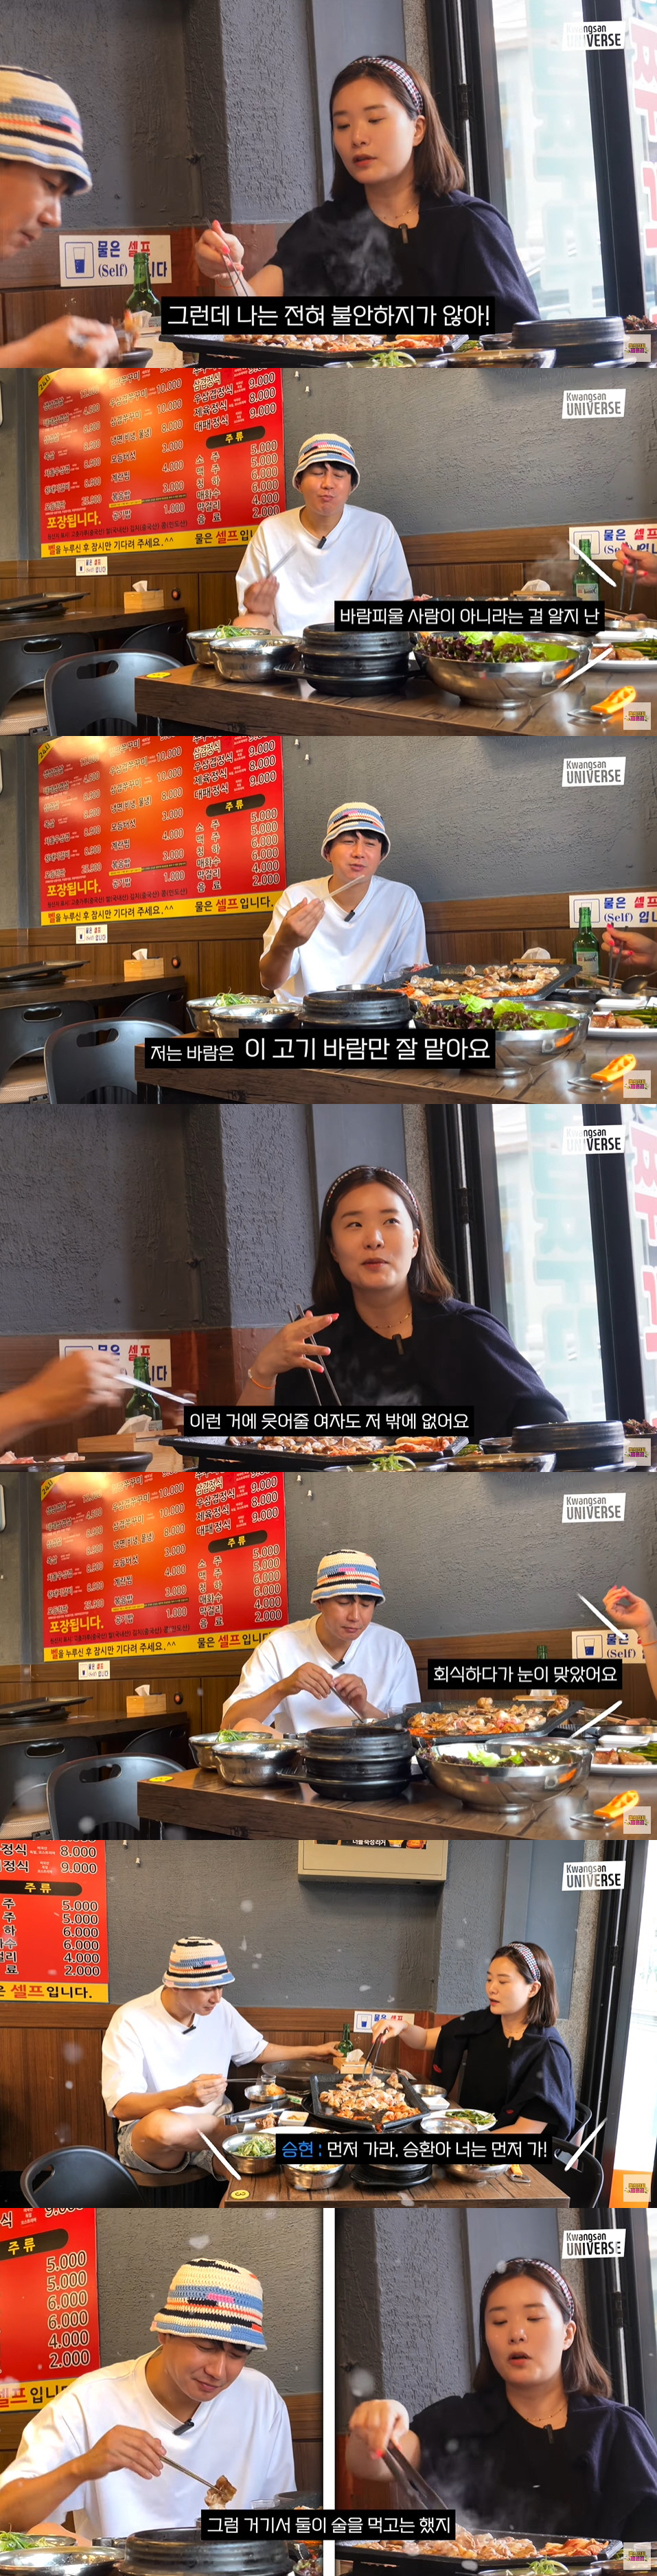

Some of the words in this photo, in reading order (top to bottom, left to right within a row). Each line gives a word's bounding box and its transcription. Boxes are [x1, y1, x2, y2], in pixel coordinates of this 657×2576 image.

[98, 240, 120, 258] 물은
[98, 264, 128, 278] (Self)
[194, 400, 228, 417] 제육정식
[249, 387, 276, 403] 8.000
[194, 415, 229, 432] 대패정식
[249, 403, 277, 419] 9.000
[47, 511, 102, 529] 포장됩니다.
[604, 529, 625, 541] 물은
[83, 543, 90, 552] 후
[91, 542, 111, 551] 잠시만
[114, 539, 135, 550] 기다려
[157, 746, 182, 762] 10.000
[194, 752, 233, 772] 우삼겹정식
[249, 740, 275, 757] 9.000
[196, 856, 220, 869] 매화수
[251, 847, 279, 861] 6.000
[197, 868, 220, 880] 막걸리
[252, 860, 279, 873] 4.000
[195, 901, 213, 912] 물은
[604, 897, 625, 909] 물은
[604, 912, 633, 923] (Self)
[164, 1544, 185, 1557] 3.000
[165, 1565, 186, 1576] 4.000
[165, 1585, 187, 1597] 3.000
[115, 1613, 134, 1625] 공기밥
[166, 1606, 187, 1618] 1.000
[607, 1648, 636, 1659] (Self)
[60, 1845, 97, 1857] 8.000
[60, 1862, 98, 1874] 9.000
[2, 1898, 16, 1910] 주
[62, 1900, 98, 1911] 5.000
[3, 1911, 16, 1923] 주
[62, 1913, 99, 1924] 5.000
[3, 1925, 16, 1936] 하
[62, 1927, 99, 1937] 6.000
[63, 1940, 100, 1951] 6.000
[63, 1953, 100, 1964] 4.000
[5, 1965, 19, 1975] 료
[65, 1966, 101, 1976] 2.000
[46, 2250, 87, 2273] 5.000
[47, 2270, 87, 2292] 5.000
[47, 2290, 88, 2311] 6.000
[47, 2310, 89, 2330] 6.000
[48, 2330, 89, 2349] 4.000
[49, 2349, 91, 2369] 2.000
